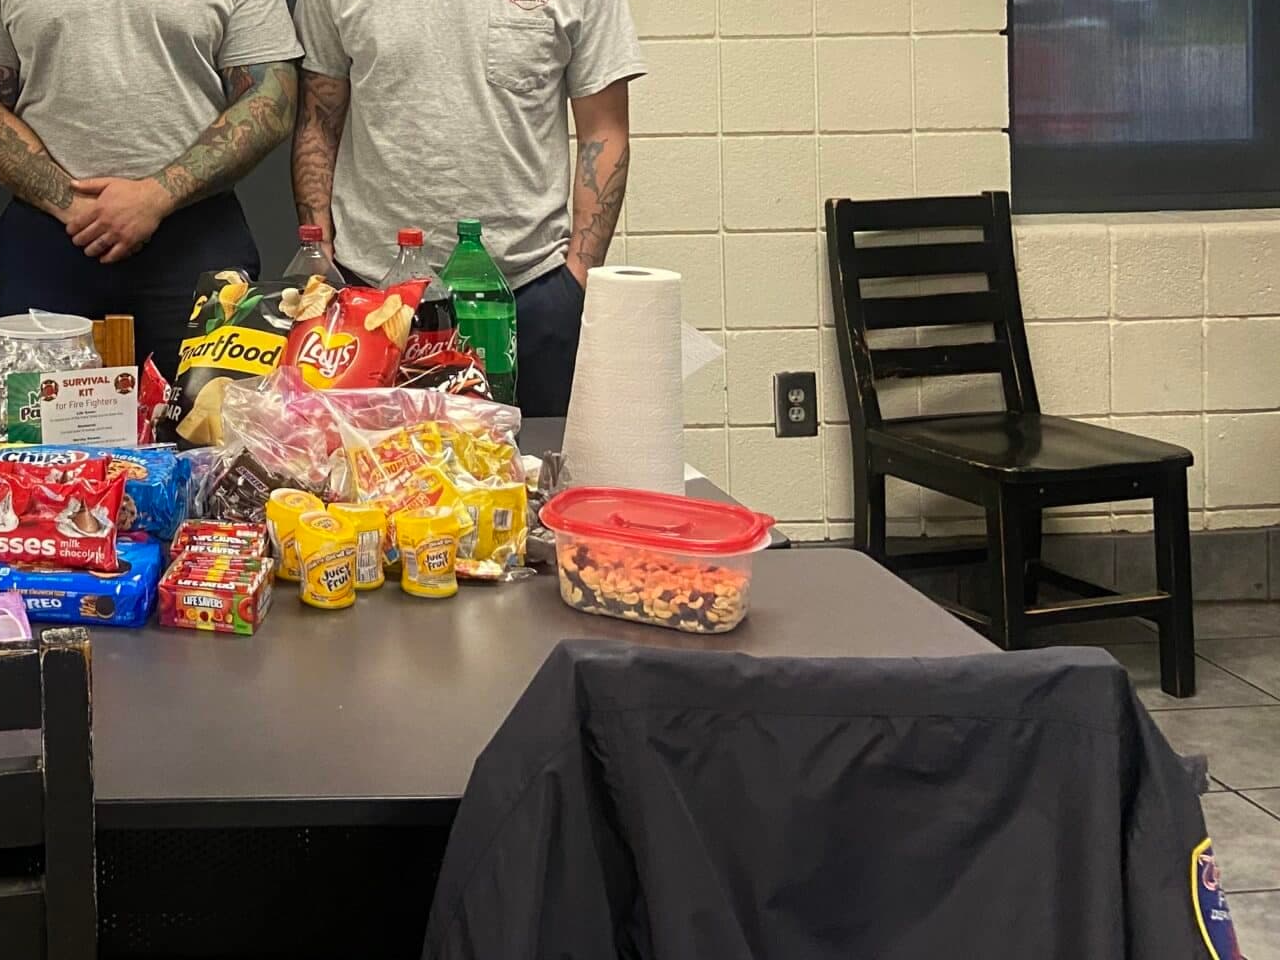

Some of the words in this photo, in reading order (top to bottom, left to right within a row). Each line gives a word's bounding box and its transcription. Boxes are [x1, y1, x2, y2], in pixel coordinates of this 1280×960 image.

[63, 375, 111, 387] SURVIVAL
[79, 388, 95, 397] KIT
[56, 401, 66, 410] for
[69, 400, 84, 408] Fire
[86, 398, 118, 408] Fighters
[60, 538, 81, 548] milk
[425, 551, 448, 564] Juicy
[322, 560, 350, 581] Juicy
[326, 568, 353, 592] Fruit
[23, 598, 63, 610] REO
